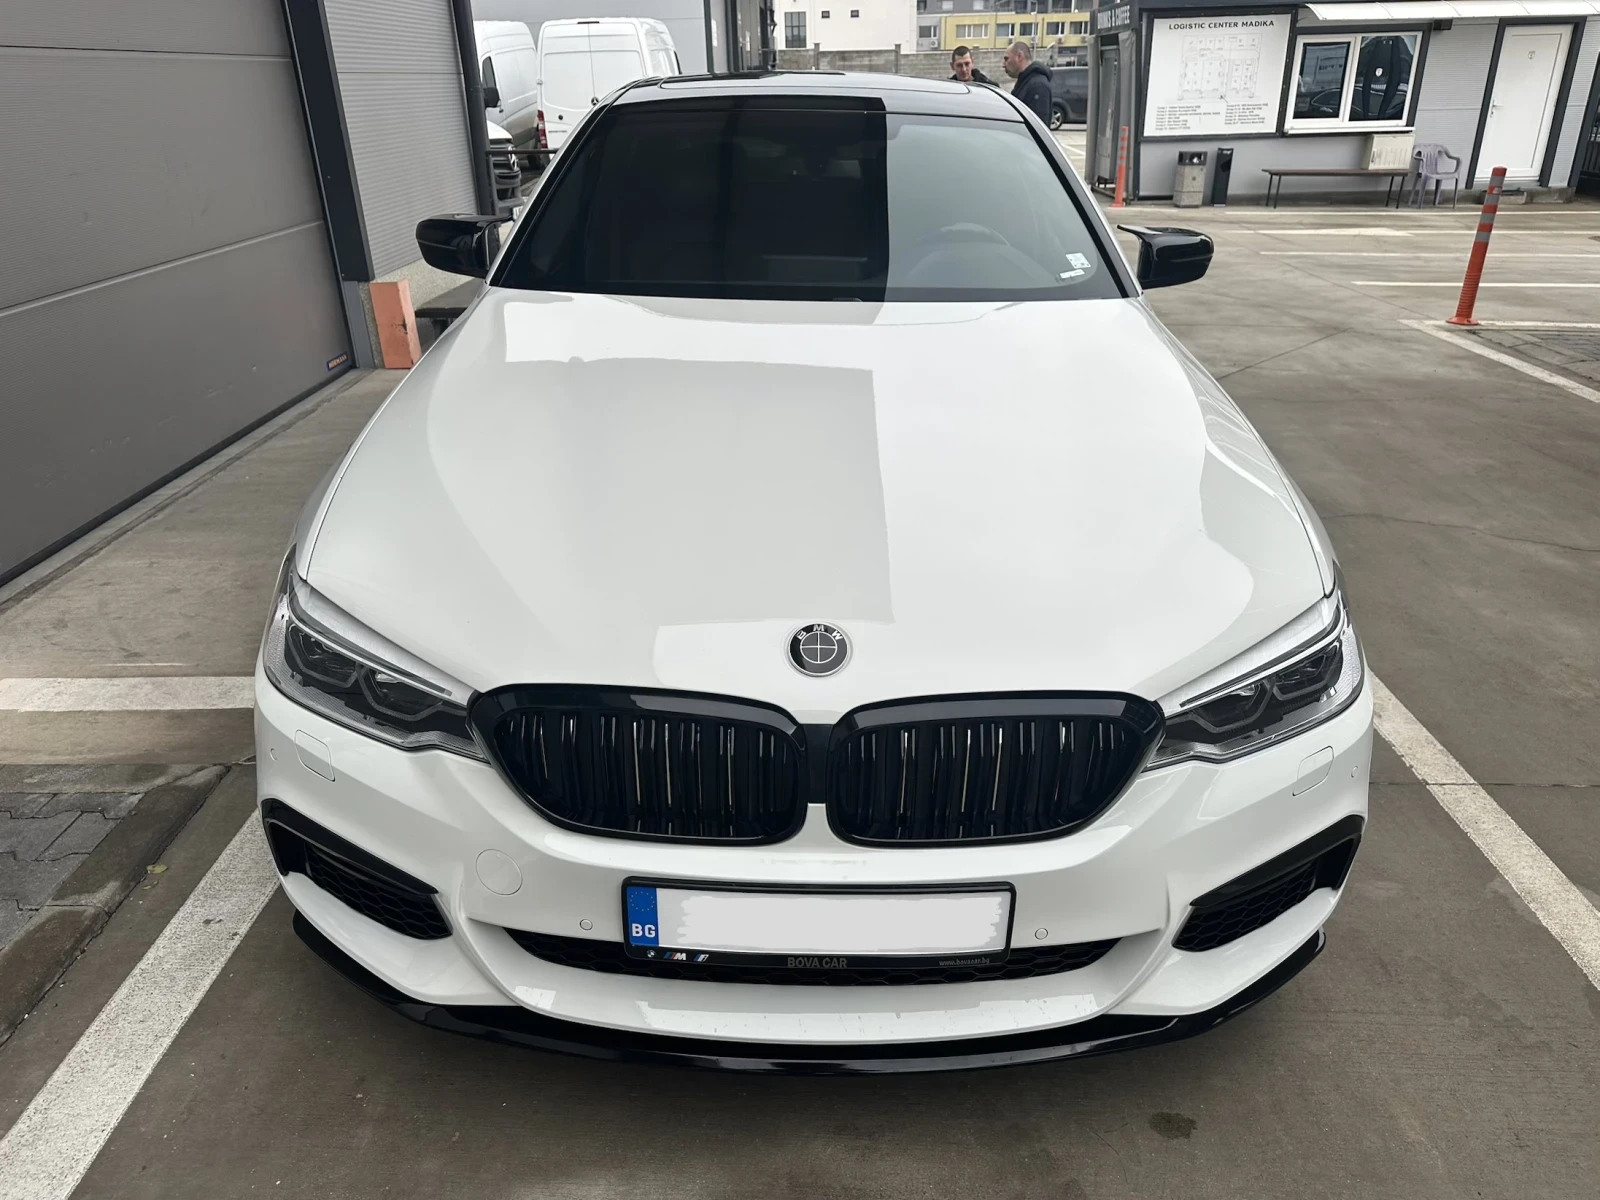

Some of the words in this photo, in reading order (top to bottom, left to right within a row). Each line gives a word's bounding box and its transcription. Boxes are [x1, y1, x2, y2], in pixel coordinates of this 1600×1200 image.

[1115, 5, 1130, 26] COFFEE
[1168, 22, 1206, 30] LOGISTIC
[1208, 21, 1239, 29] CENTER
[1241, 20, 1275, 28] MADIKA
[796, 624, 844, 640] BMW
[632, 923, 656, 938] BG
[787, 956, 820, 968] BOVA
[822, 957, 848, 968] CAR
[938, 956, 990, 966] www.bovacar.bg
